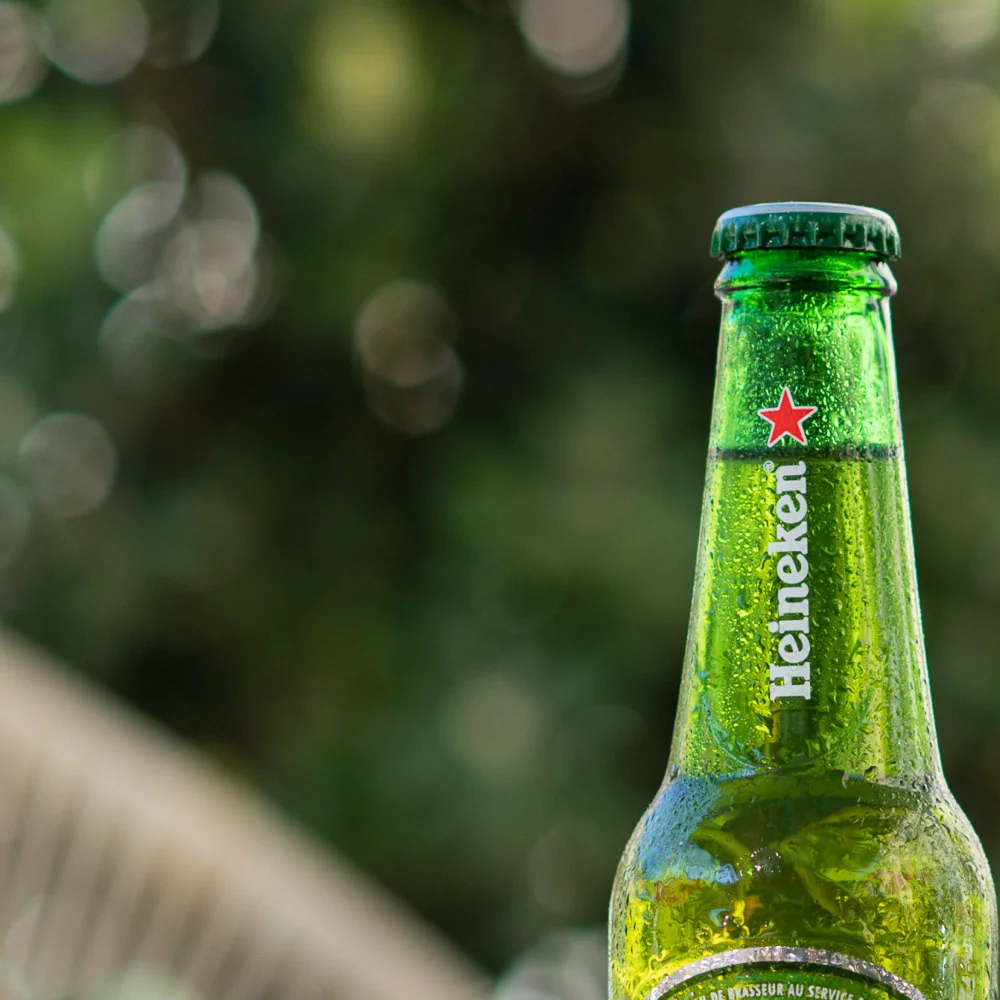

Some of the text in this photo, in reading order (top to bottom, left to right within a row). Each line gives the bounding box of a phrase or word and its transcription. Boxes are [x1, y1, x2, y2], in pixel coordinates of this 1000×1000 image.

[768, 461, 811, 701] Heineken
[728, 983, 783, 1000] BRASSEUR
[787, 983, 804, 997] AU
